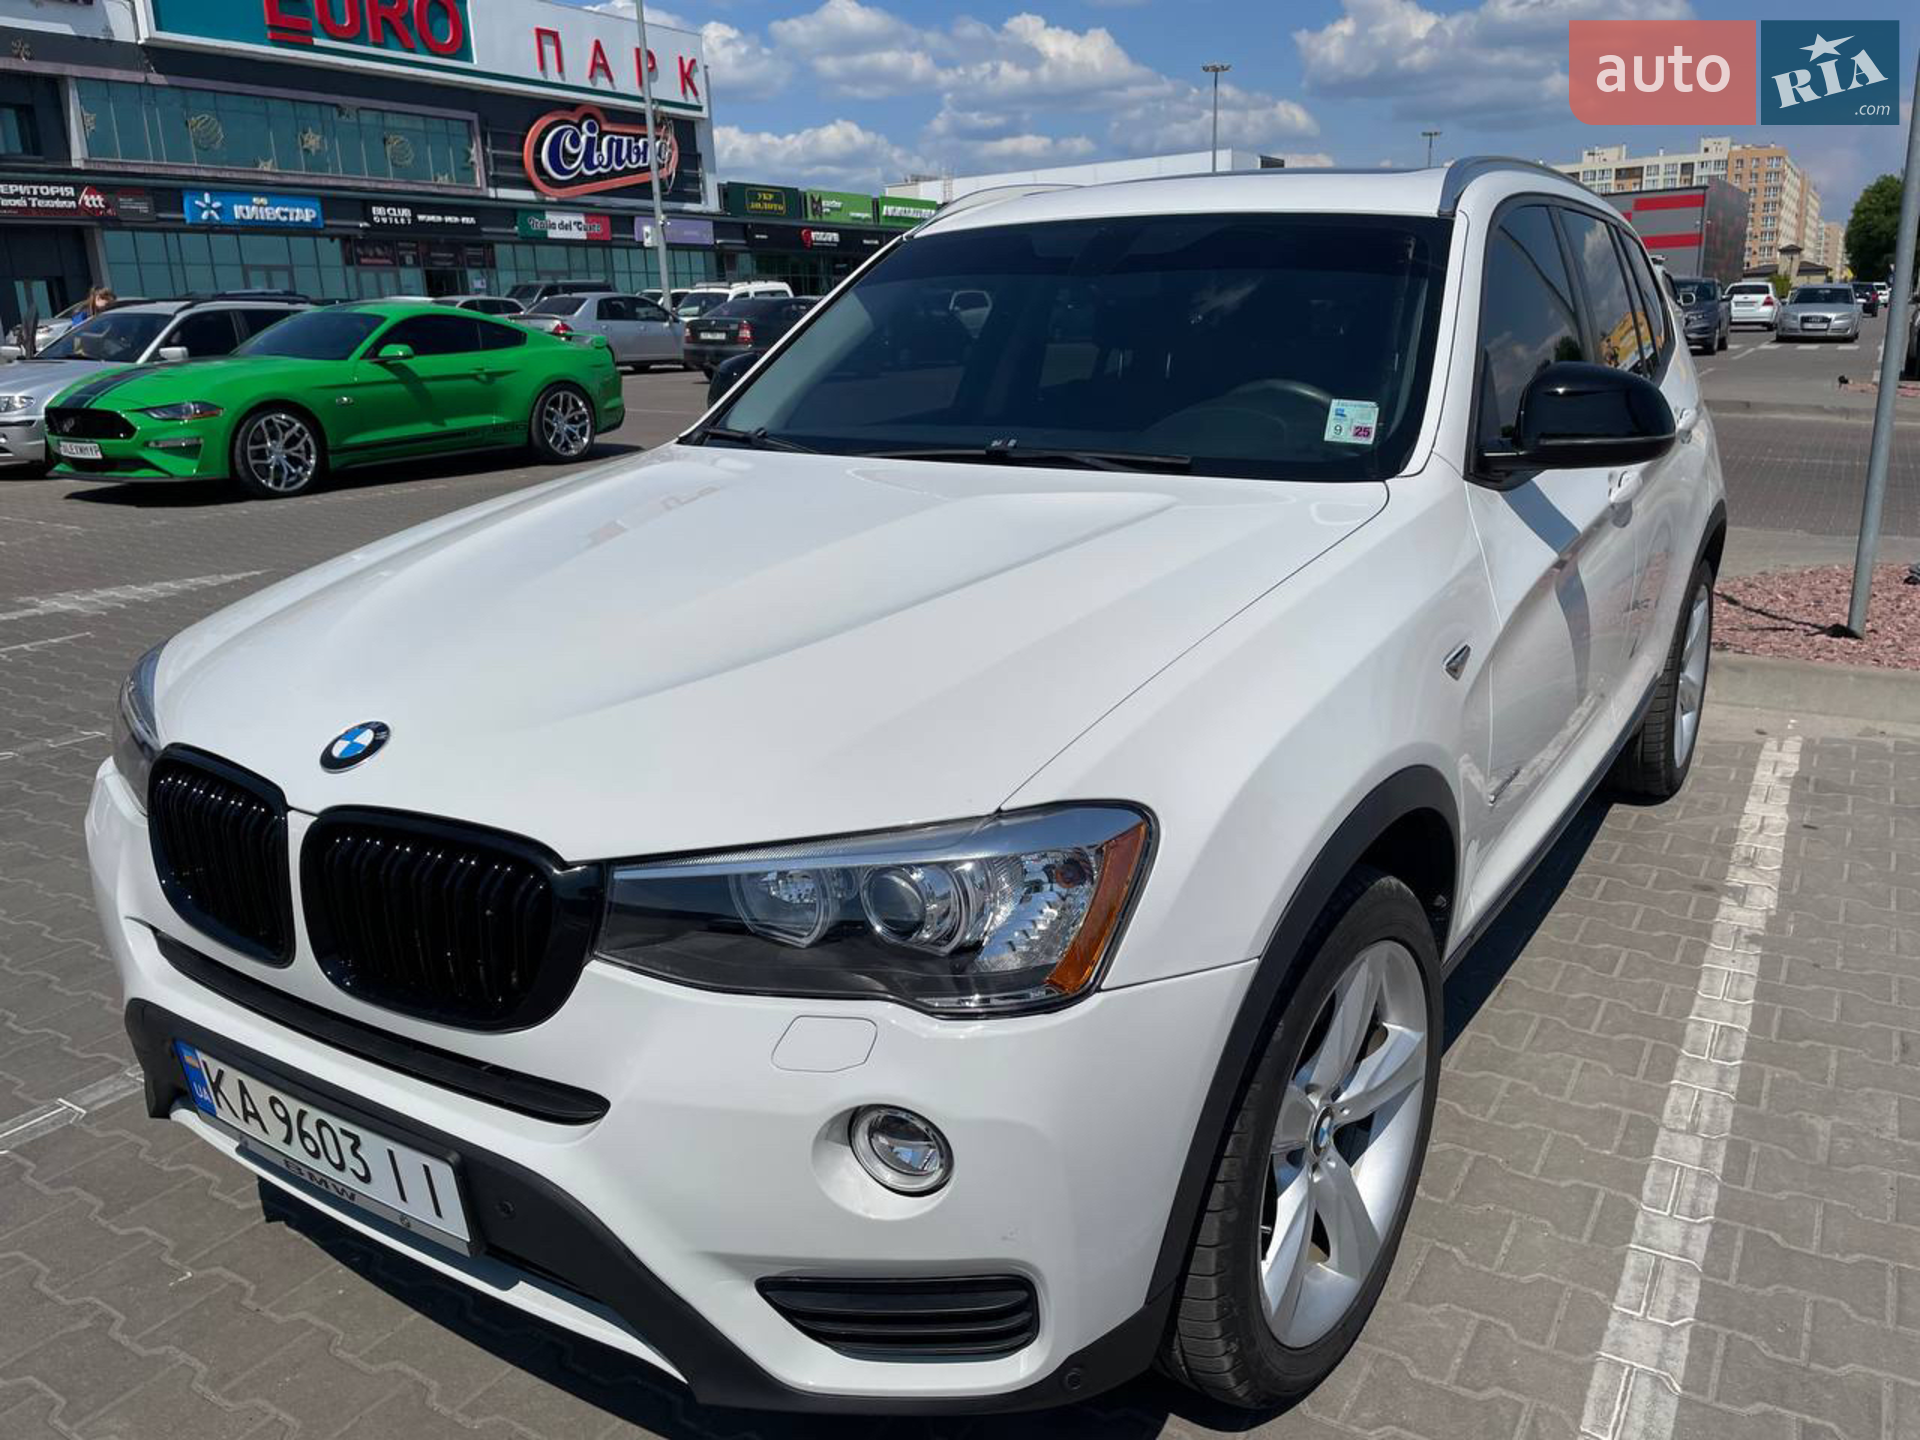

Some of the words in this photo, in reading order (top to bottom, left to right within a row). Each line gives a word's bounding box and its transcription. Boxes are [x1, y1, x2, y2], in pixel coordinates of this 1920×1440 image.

[535, 27, 700, 97] ПАРК
[1334, 425, 1342, 435] 9
[1354, 426, 1370, 437] 25
[268, 1095, 372, 1185] 9603
[283, 1159, 357, 1202] BMW
